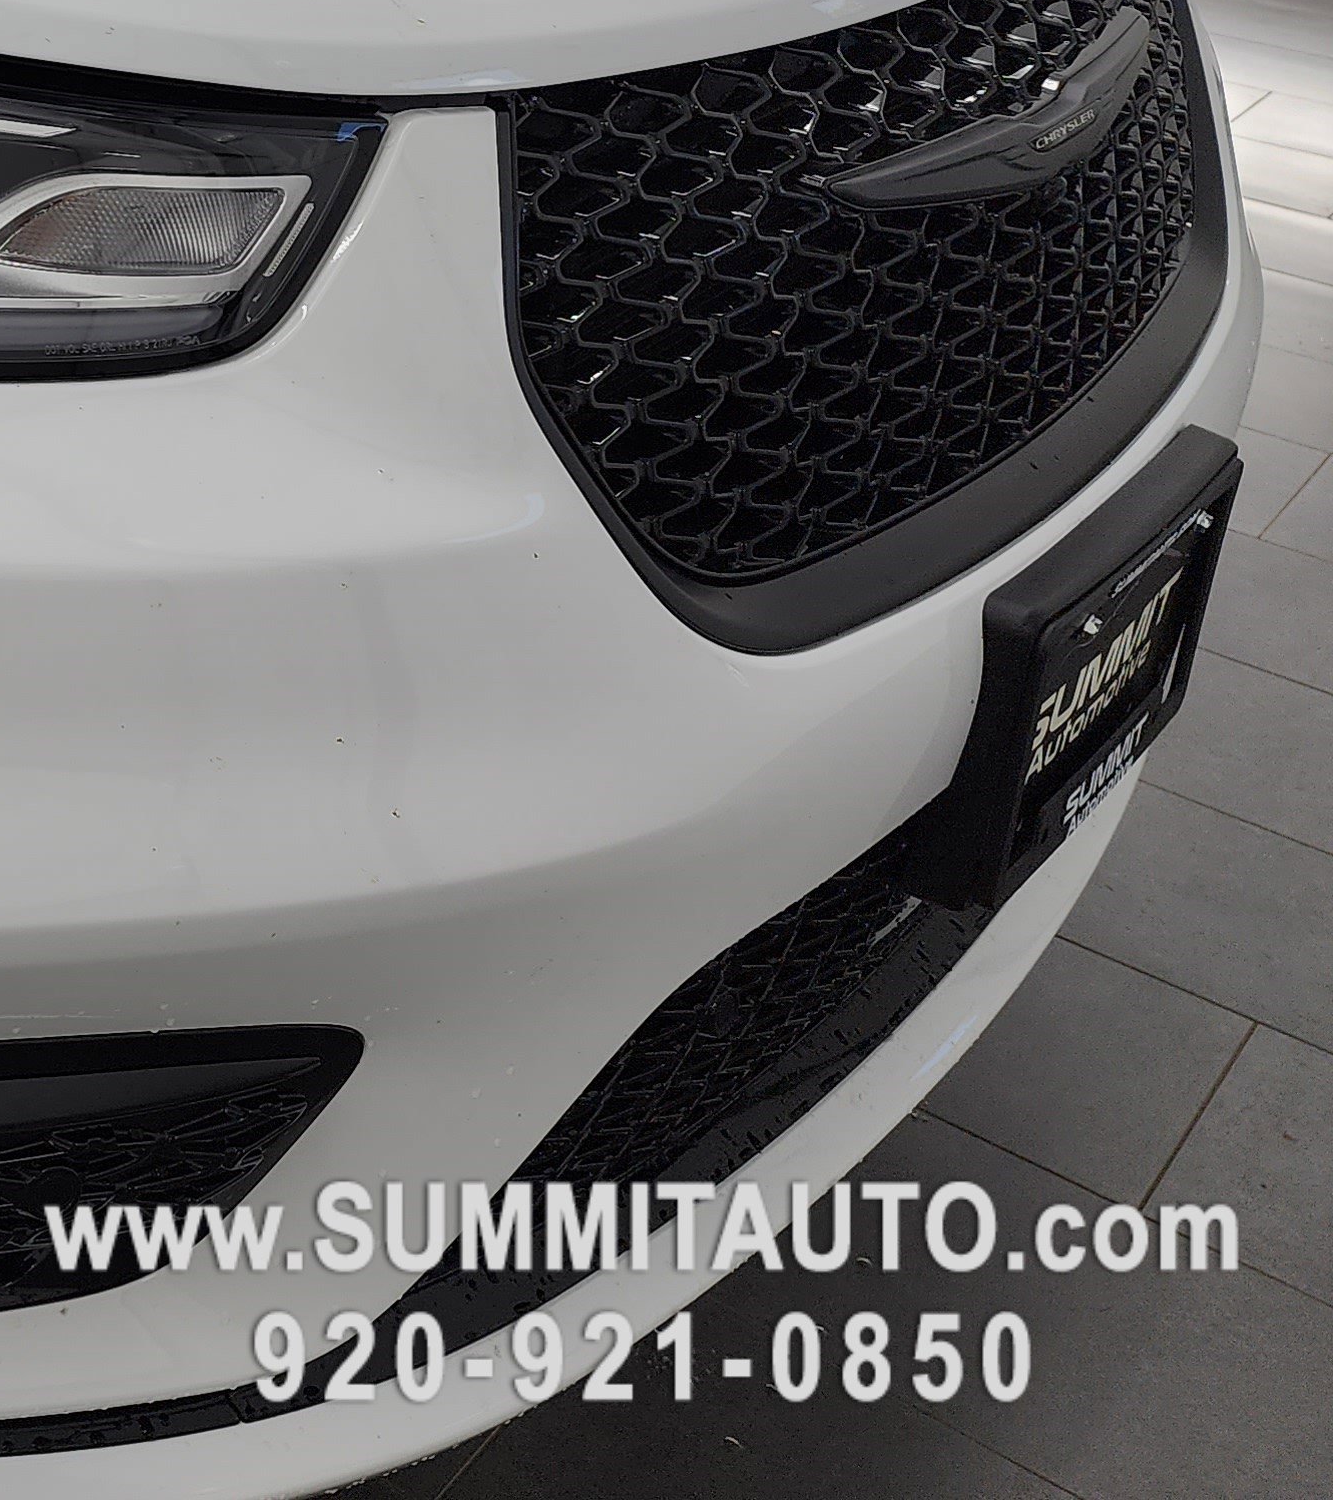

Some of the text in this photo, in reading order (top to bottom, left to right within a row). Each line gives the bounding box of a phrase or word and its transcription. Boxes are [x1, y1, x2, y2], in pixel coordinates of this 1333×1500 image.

[1035, 108, 1096, 150] CHRYSLER
[1023, 638, 1152, 786] Automotive
[1031, 566, 1184, 752] SUMMIT
[1063, 711, 1149, 826] SUMMIT
